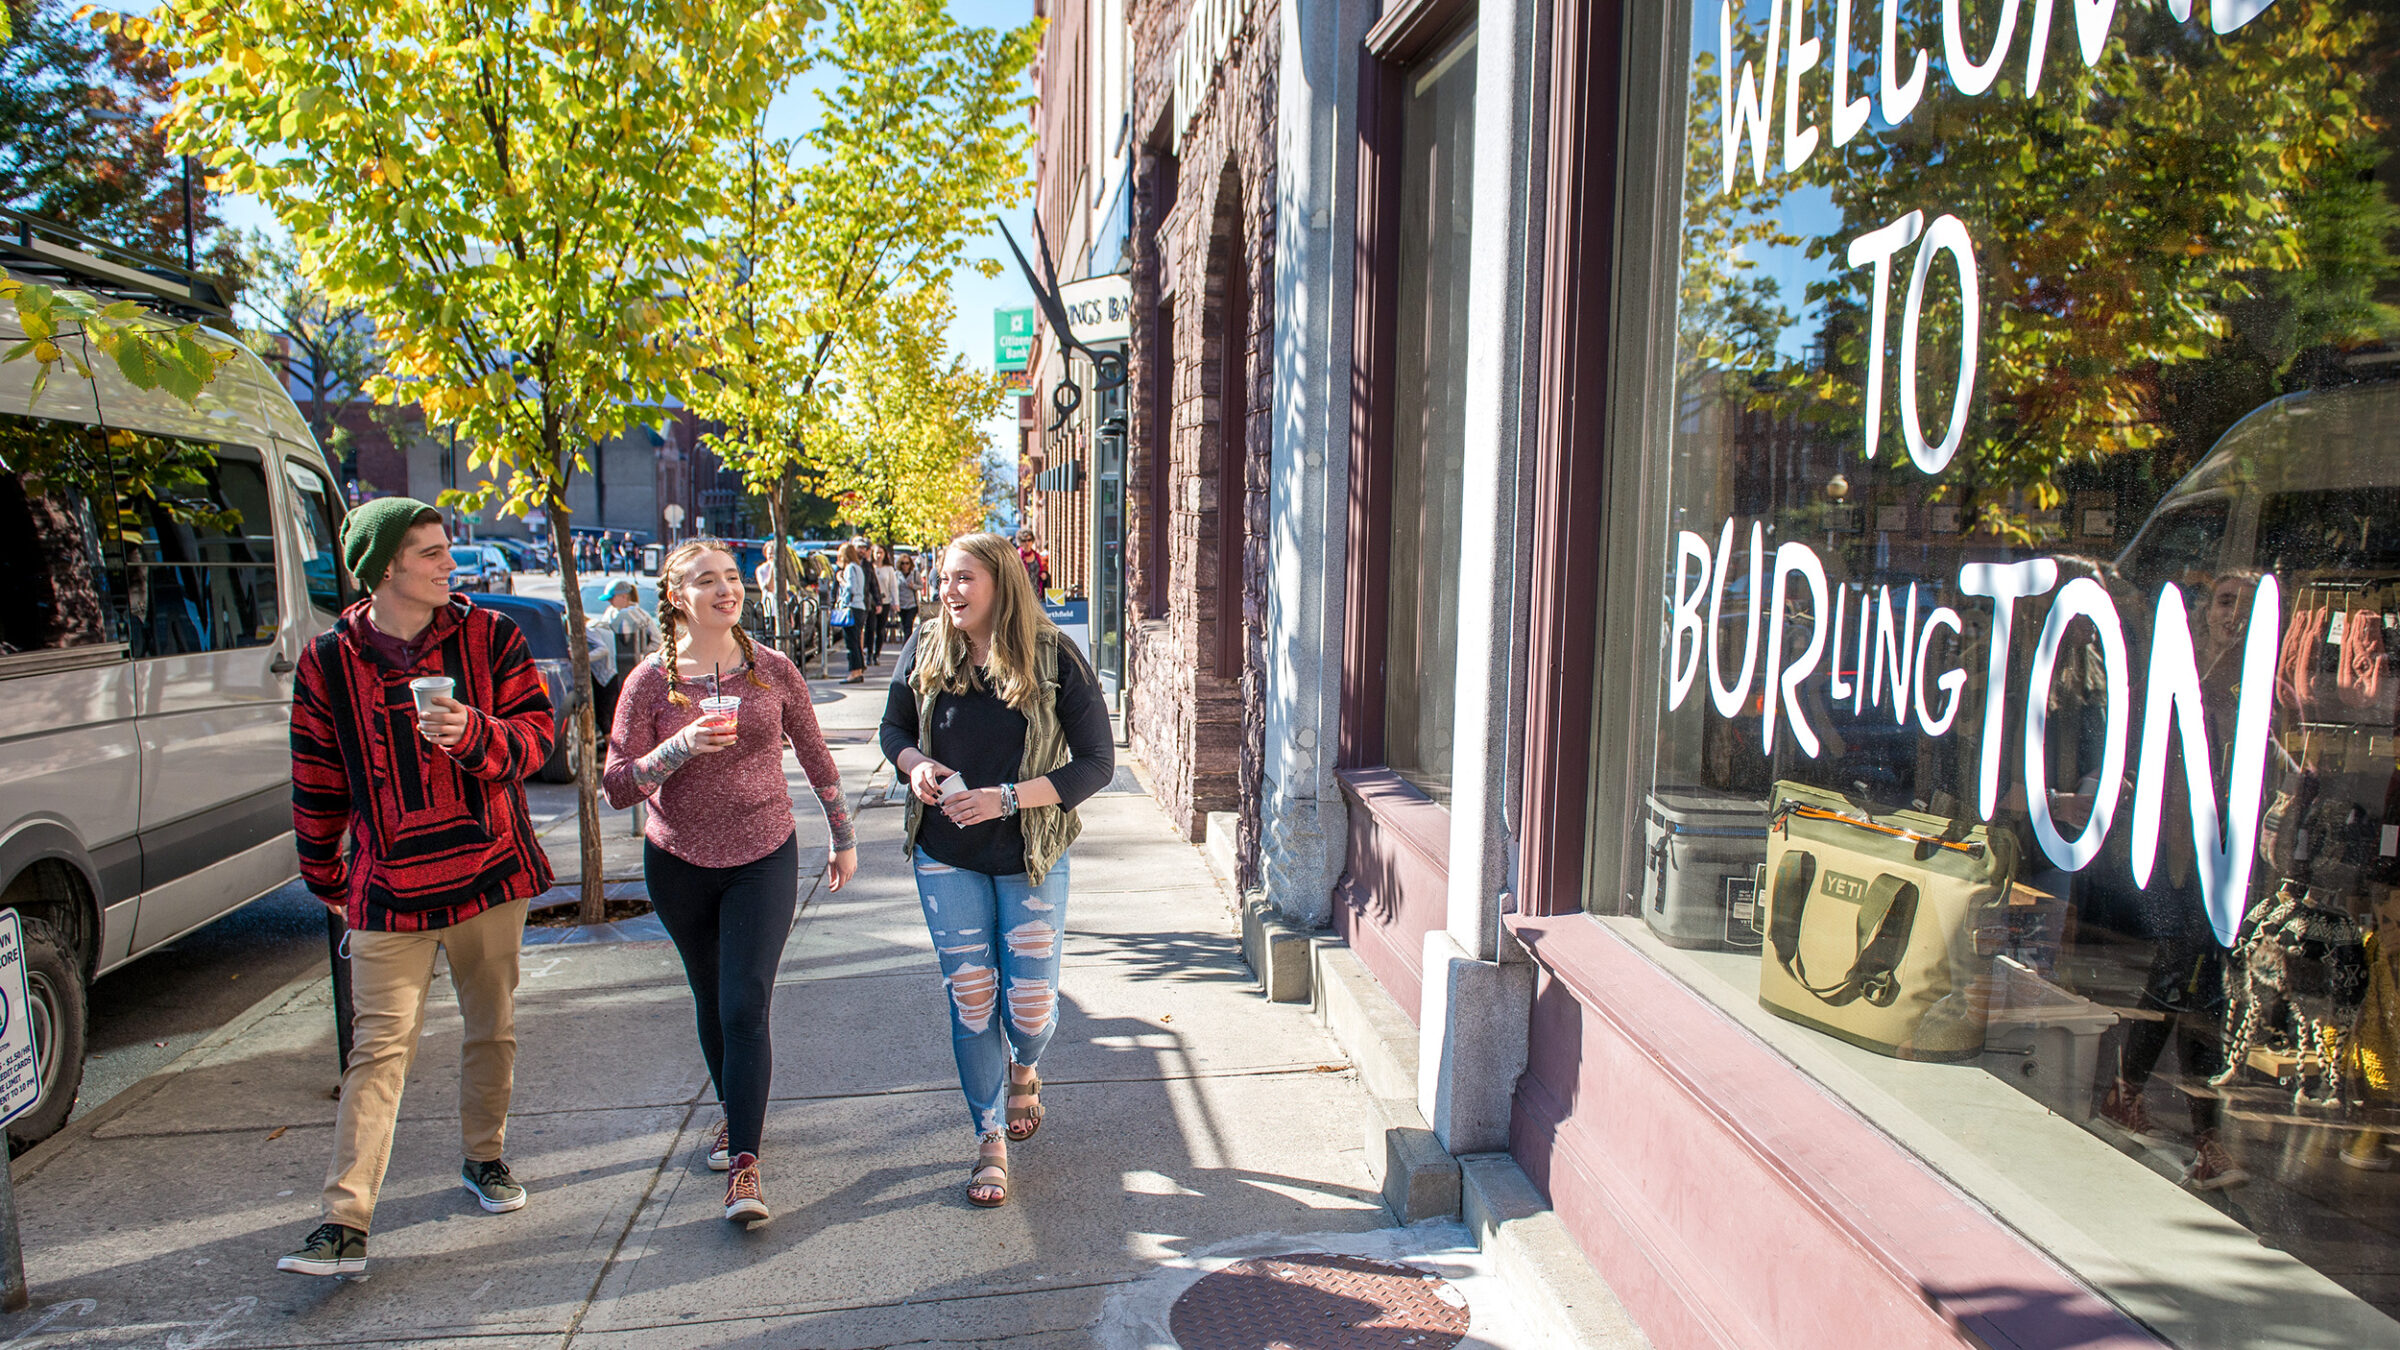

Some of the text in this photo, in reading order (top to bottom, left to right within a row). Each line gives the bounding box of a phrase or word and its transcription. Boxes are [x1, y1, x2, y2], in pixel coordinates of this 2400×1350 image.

[1720, 0, 2275, 196] WELC
[1847, 208, 1979, 475] TO
[1006, 347, 1027, 359] Bank
[1669, 516, 2279, 948] BURLINGTON
[1827, 875, 1863, 899] YETI
[0, 948, 18, 969] ORE
[13, 1055, 32, 1072] CARDS
[5, 1073, 21, 1090] LIMIT
[10, 1087, 18, 1098] TO
[19, 1082, 26, 1093] 10
[27, 1076, 35, 1087] PM
